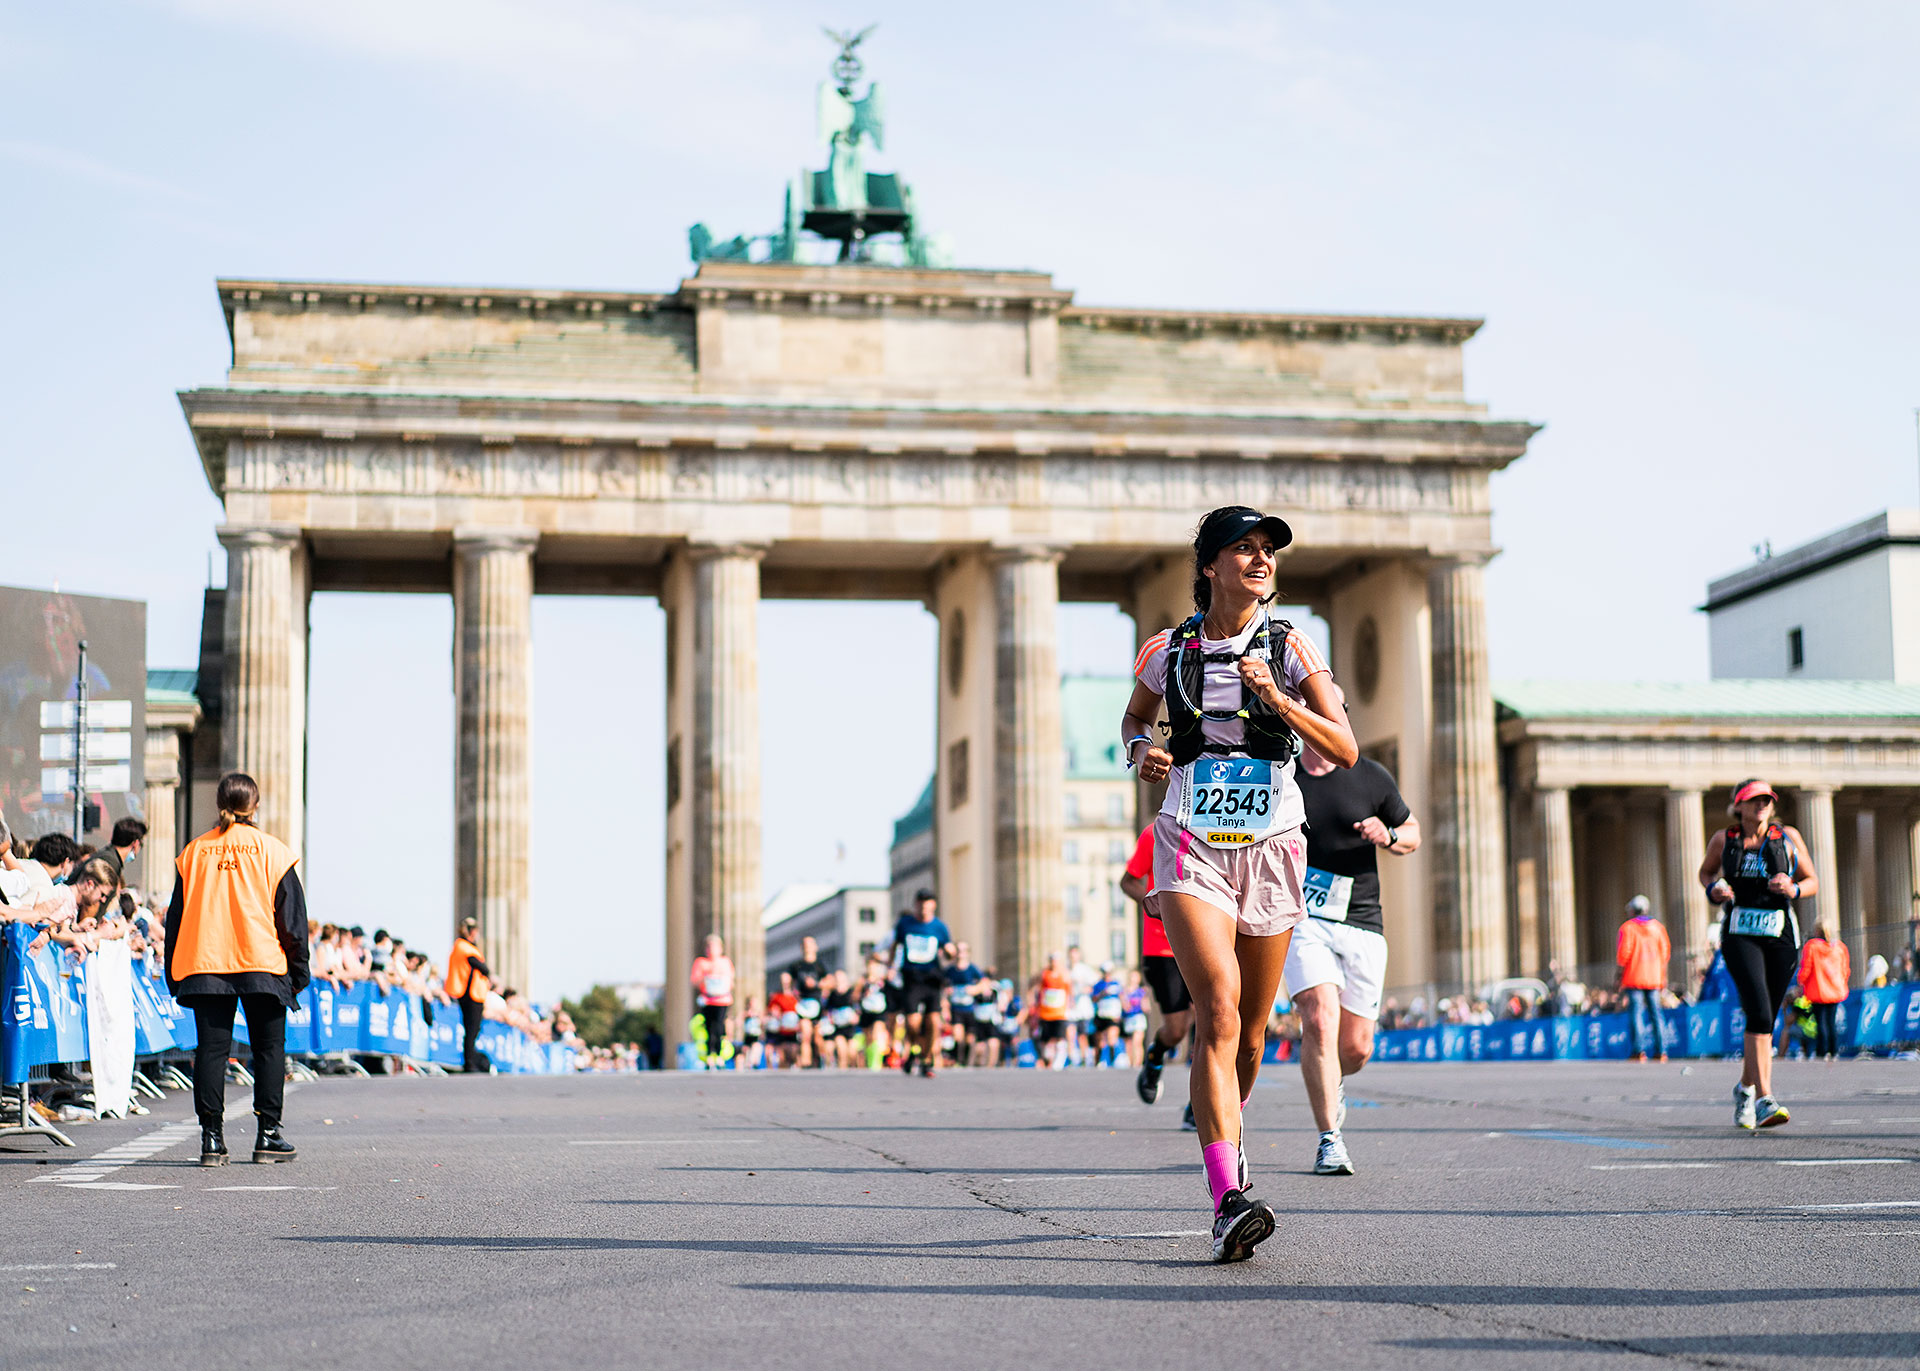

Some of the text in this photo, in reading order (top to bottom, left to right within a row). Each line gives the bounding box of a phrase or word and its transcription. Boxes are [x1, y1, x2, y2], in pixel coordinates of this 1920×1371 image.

[1194, 788, 1269, 816] 22543
[1216, 816, 1245, 829] Tanya
[1210, 834, 1237, 842] Giti
[201, 844, 259, 857] STEWARD
[217, 860, 238, 871] 625
